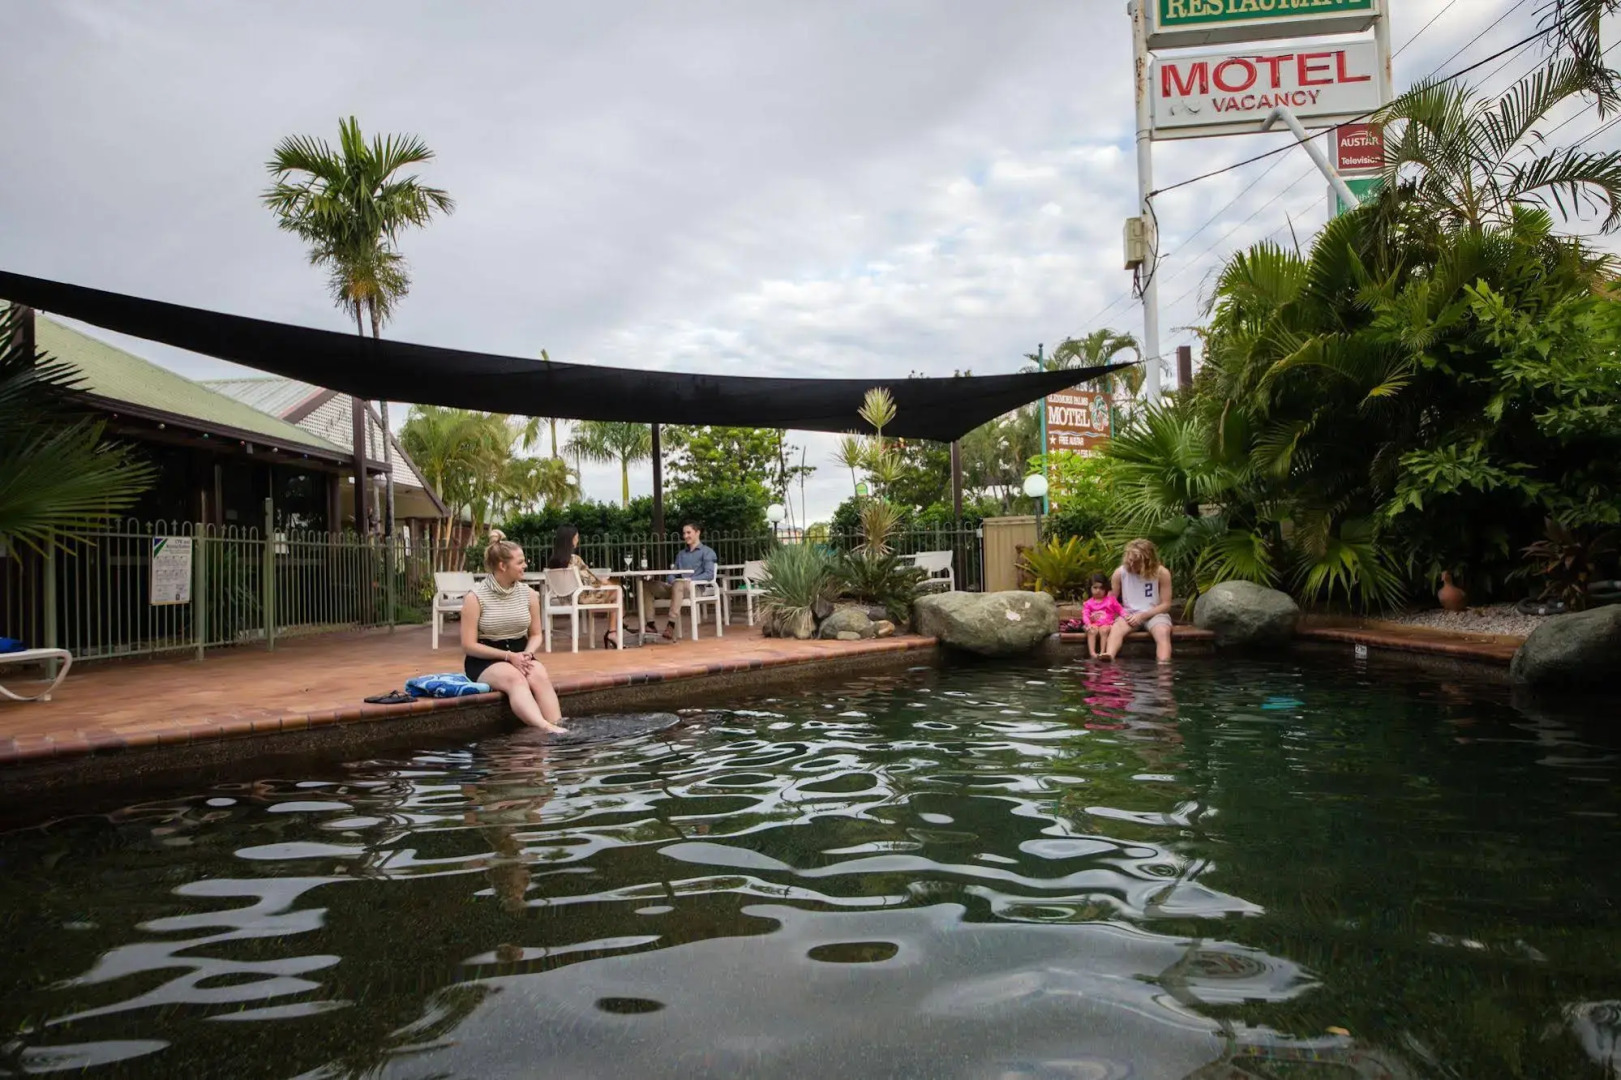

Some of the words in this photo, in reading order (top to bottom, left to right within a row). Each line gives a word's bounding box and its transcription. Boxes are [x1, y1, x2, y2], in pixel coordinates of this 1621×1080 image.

[1166, 0, 1362, 18] RESTAU
[1161, 51, 1371, 97] MOTEL
[1212, 89, 1320, 112] VACANCY
[1341, 136, 1379, 147] AUSTAR
[1048, 406, 1091, 427] MOTEL
[1145, 583, 1152, 597] 2
